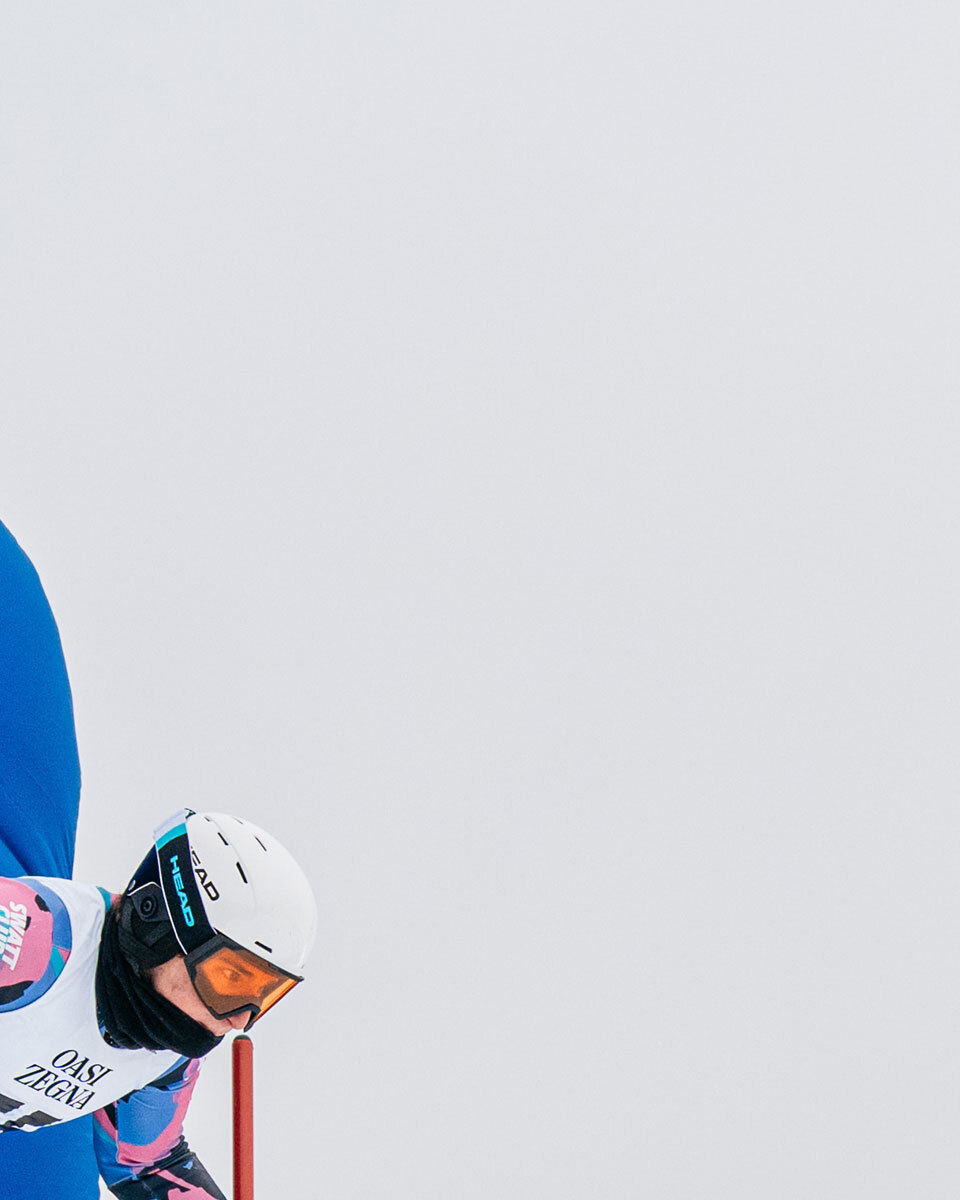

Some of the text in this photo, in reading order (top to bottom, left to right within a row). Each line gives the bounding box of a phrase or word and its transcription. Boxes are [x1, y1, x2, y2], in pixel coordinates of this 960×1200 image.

[169, 854, 195, 928] HEAD
[191, 845, 220, 901] EAD
[8, 900, 28, 971] SWATT
[13, 1064, 97, 1111] ZEGNA
[51, 1049, 113, 1084] OASI
